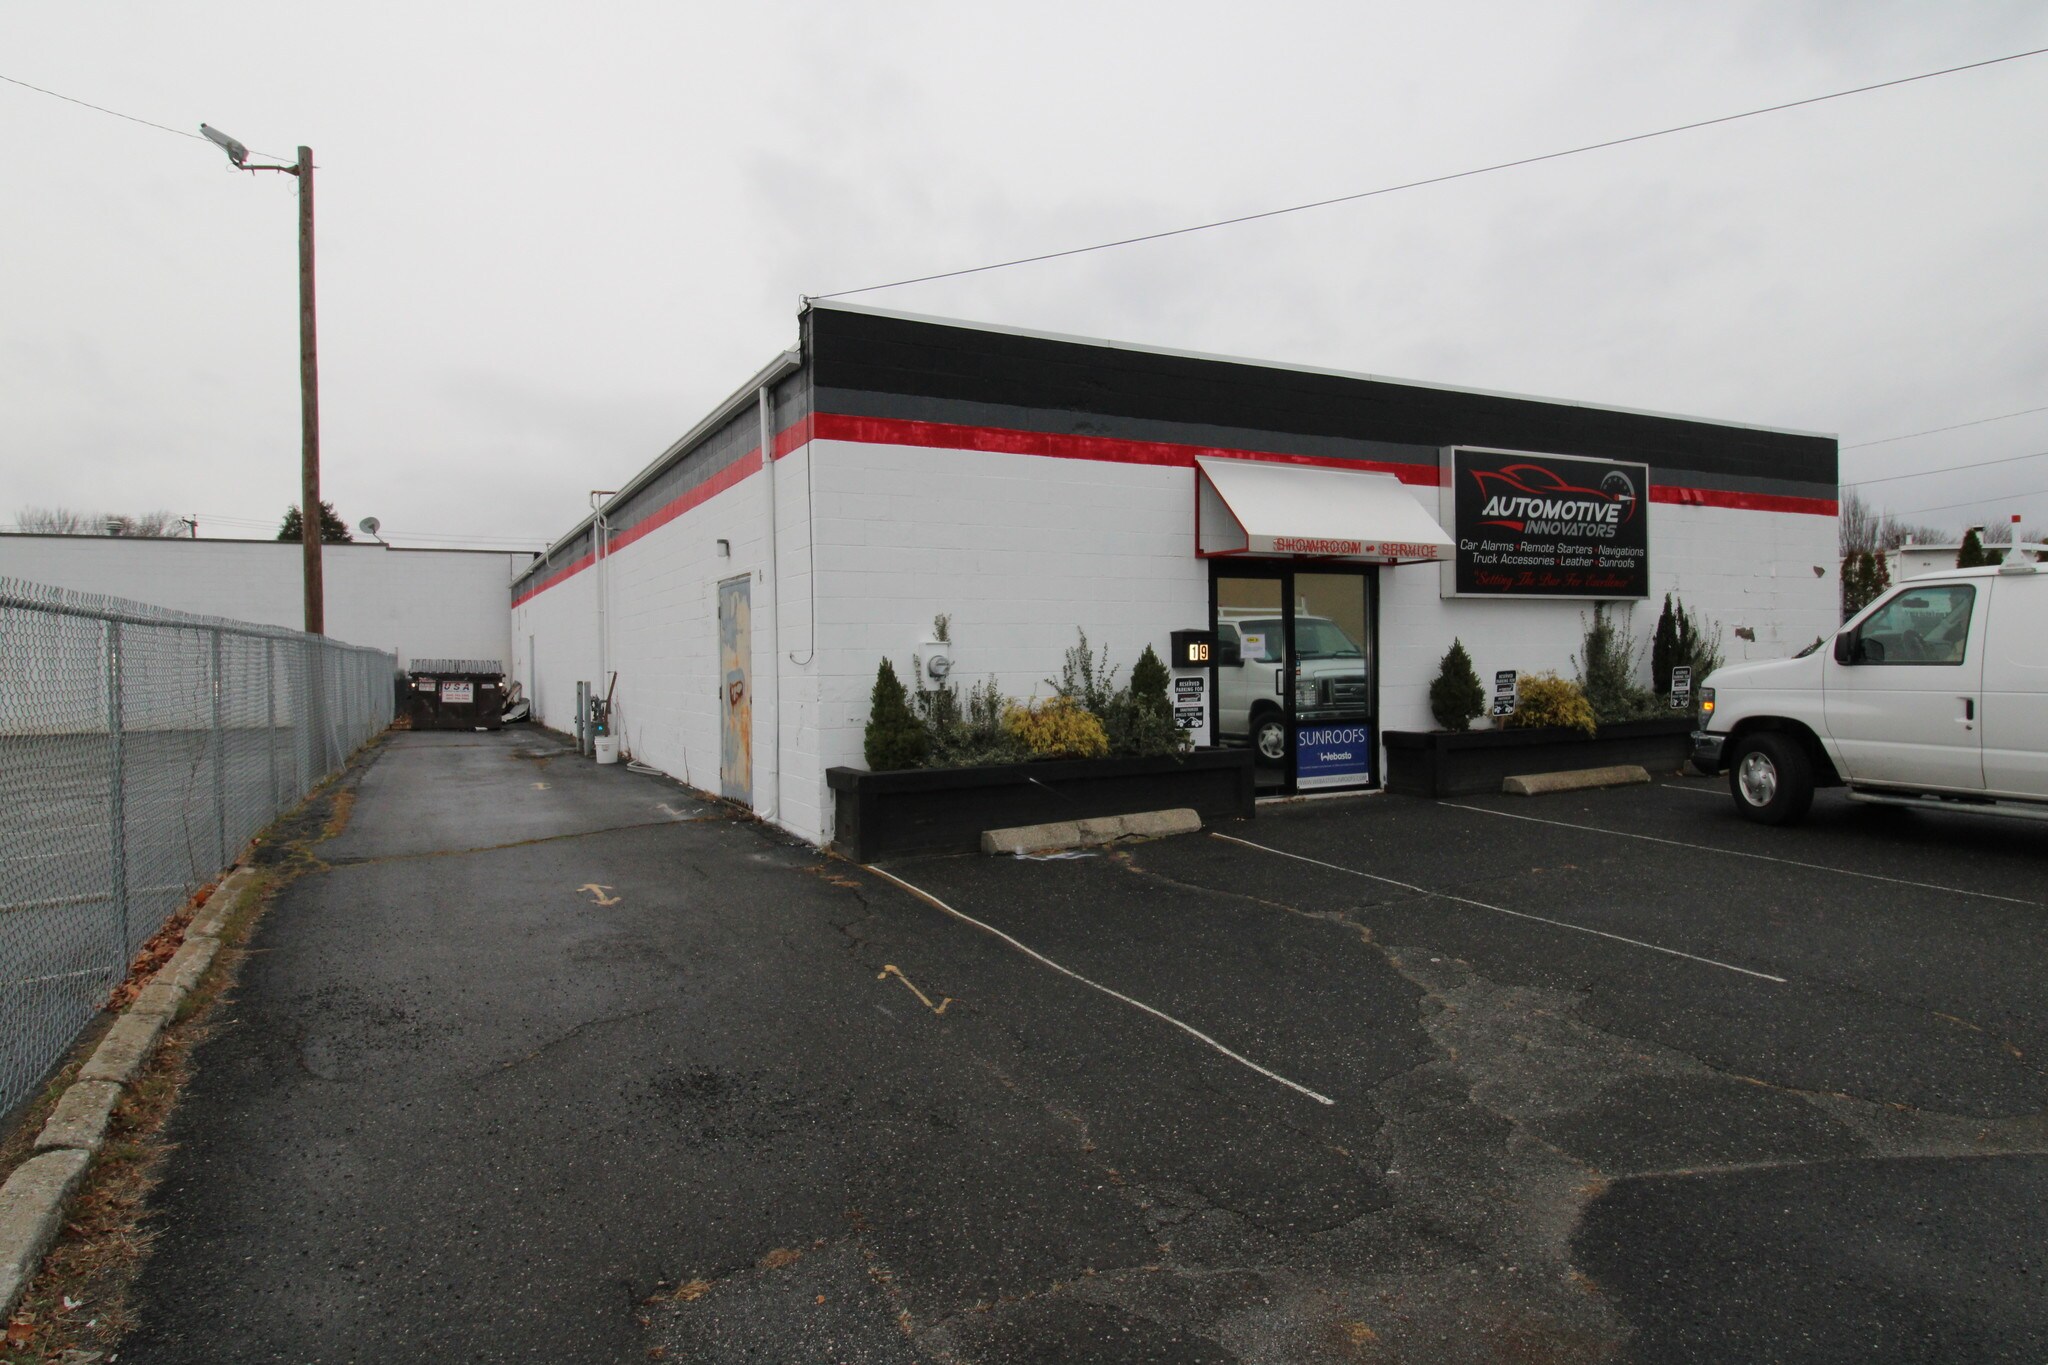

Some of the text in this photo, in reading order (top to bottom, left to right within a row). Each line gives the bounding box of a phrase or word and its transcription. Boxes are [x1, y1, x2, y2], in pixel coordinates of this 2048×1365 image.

[1482, 495, 1622, 523] AUTOMOTIVE
[1524, 519, 1617, 538] INNOVATORS
[1274, 537, 1438, 558] SHOWROOM SERVICE
[1460, 538, 1644, 558] Car Alarms Remote Starters Navigations
[1473, 552, 1635, 568] Truck Accessories Leather Sunroofs
[1190, 645, 1207, 659] 19
[1299, 728, 1365, 747] SUNROOFS
[1320, 751, 1352, 762] Webasto
